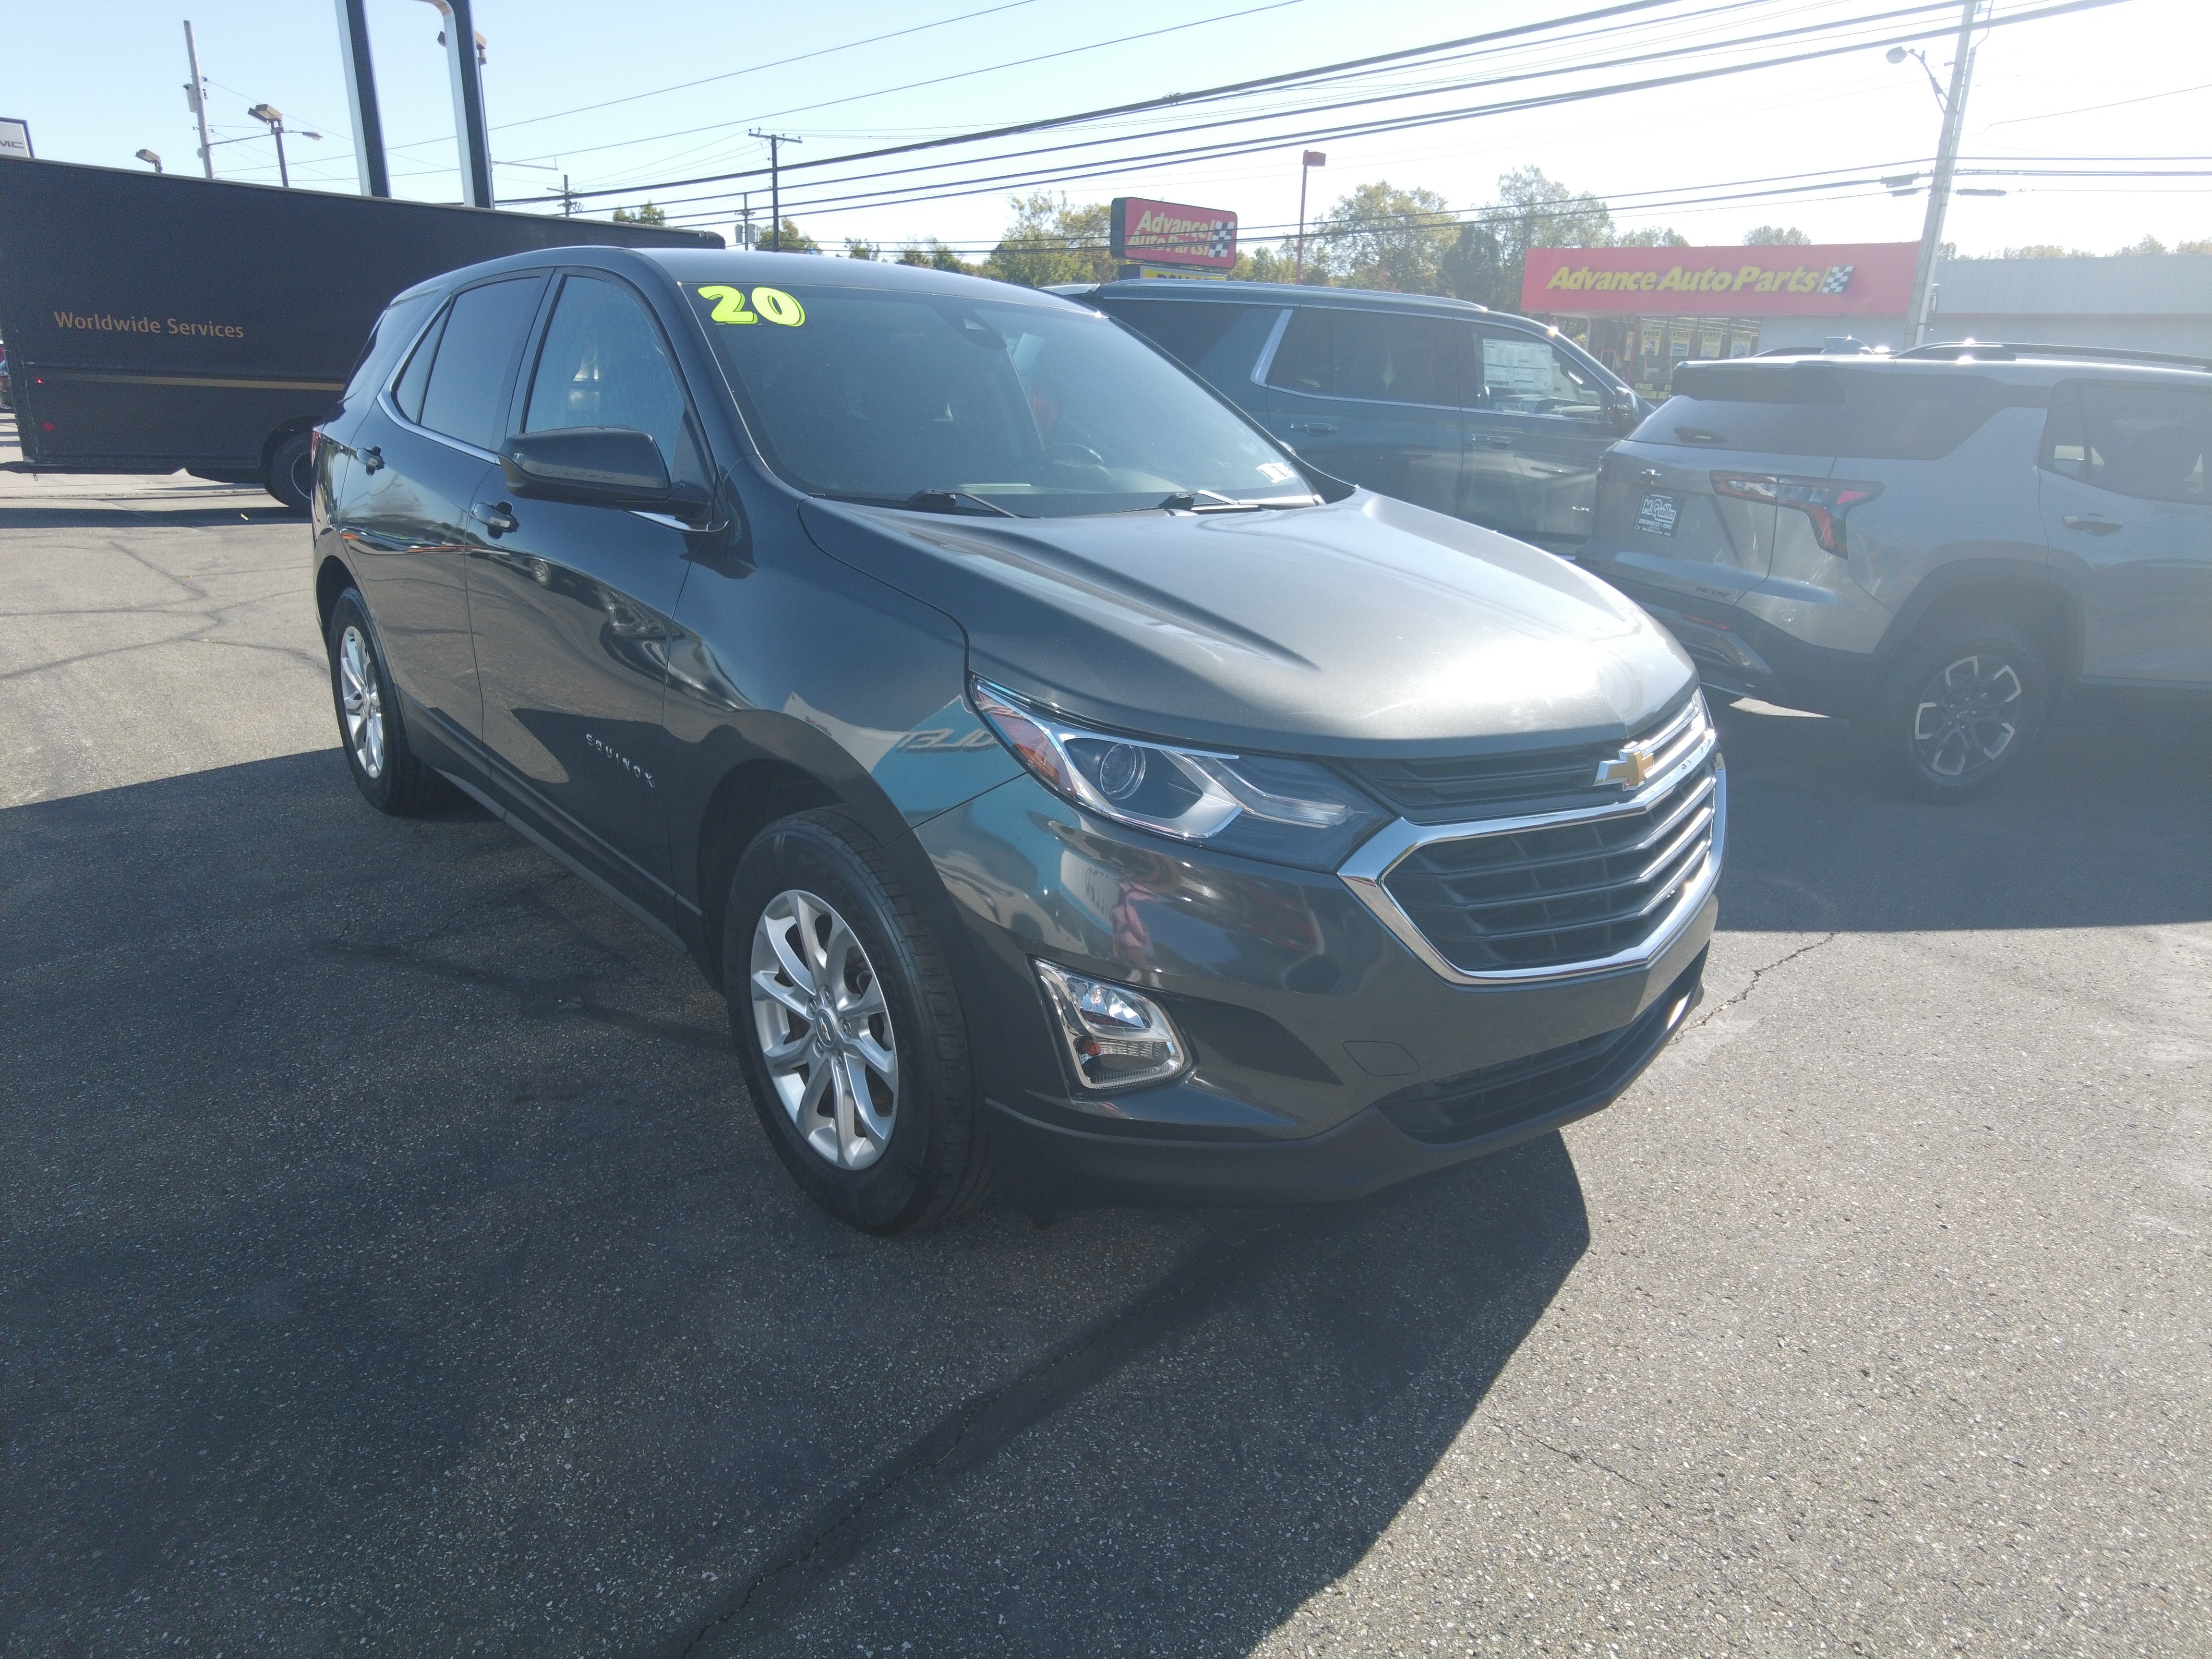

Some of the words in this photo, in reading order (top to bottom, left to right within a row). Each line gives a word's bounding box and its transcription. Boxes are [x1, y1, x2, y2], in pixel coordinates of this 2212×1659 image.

[1136, 210, 1209, 239] Advance
[1128, 230, 1166, 251] Auto
[1166, 234, 1206, 256] Parts
[1546, 266, 1658, 291] Advance
[1658, 266, 1733, 291] Auto
[1731, 265, 1822, 293] Parts
[698, 285, 806, 327] 20
[53, 311, 161, 334] Worldwide
[168, 318, 245, 338] Services
[586, 733, 656, 788] EQUINOX
